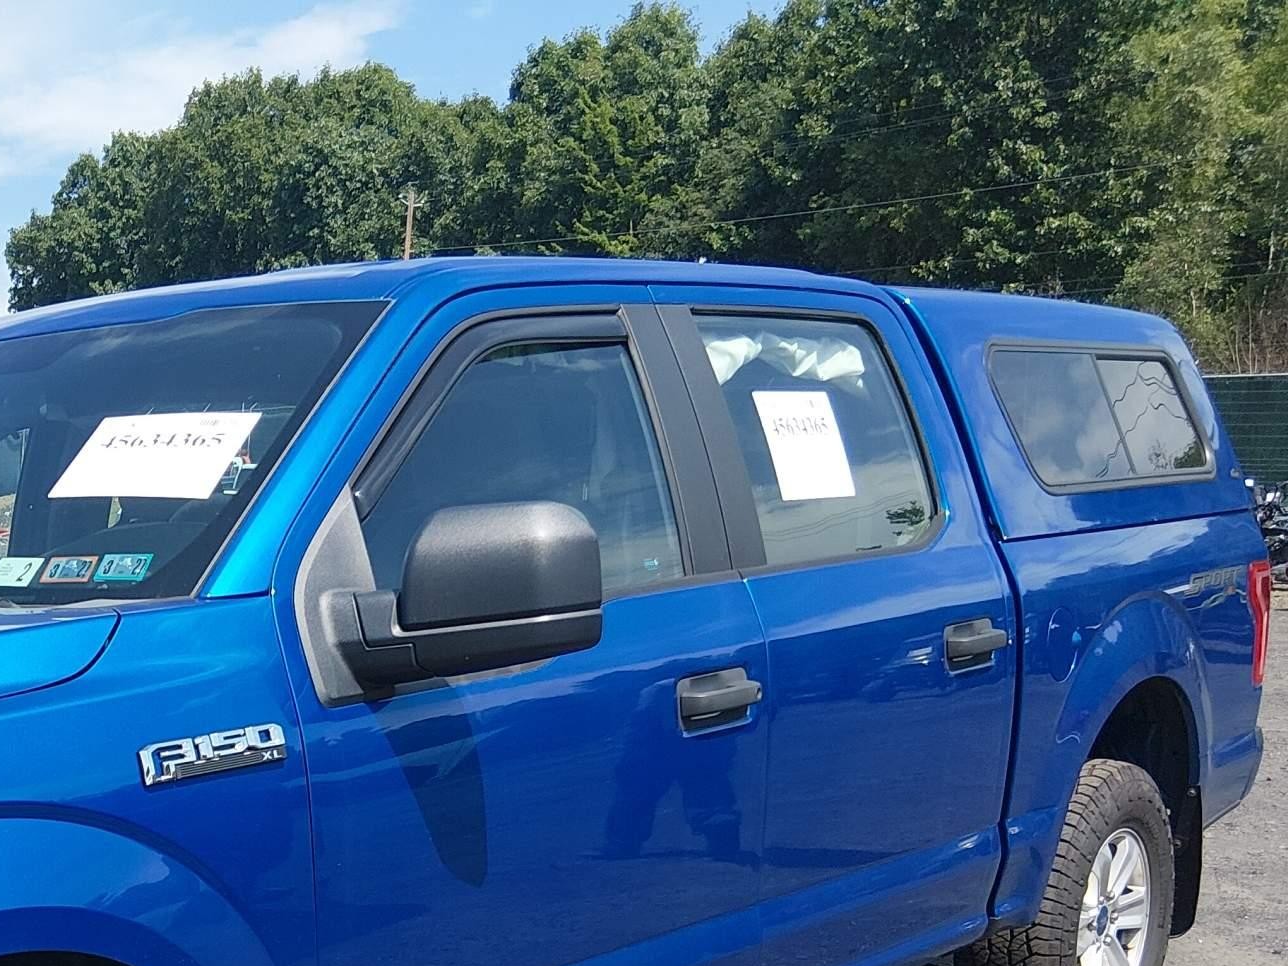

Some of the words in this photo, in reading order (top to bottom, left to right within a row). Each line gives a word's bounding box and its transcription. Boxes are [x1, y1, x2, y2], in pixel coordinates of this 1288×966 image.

[773, 416, 828, 437] 45634365
[101, 432, 225, 449] 45634365
[16, 562, 33, 582] 2
[49, 563, 61, 578] 3
[77, 560, 93, 577] 27
[103, 559, 114, 575] 3
[132, 558, 148, 576] 27
[261, 749, 283, 761] XL
